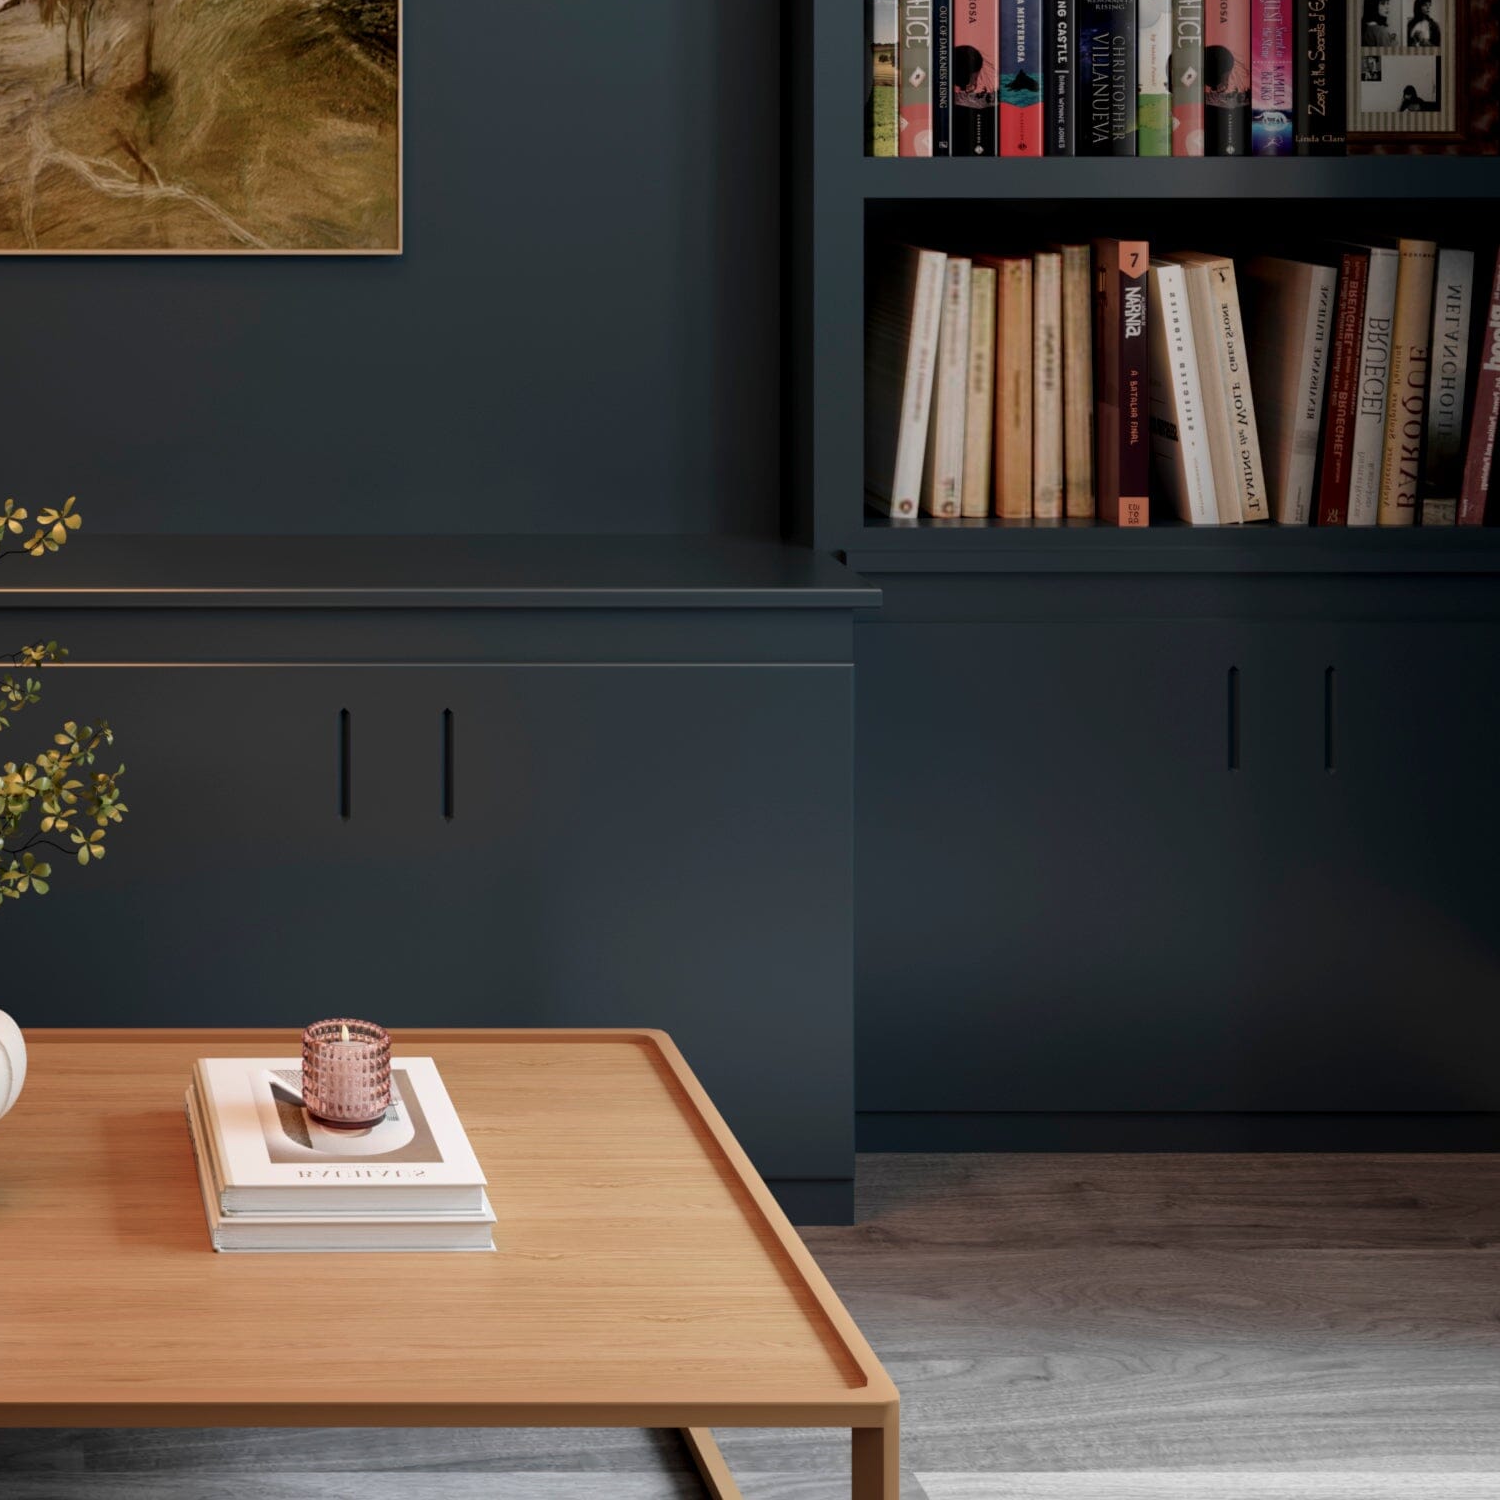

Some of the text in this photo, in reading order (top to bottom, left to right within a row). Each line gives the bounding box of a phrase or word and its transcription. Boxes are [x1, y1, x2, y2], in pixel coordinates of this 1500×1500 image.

[1016, 10, 1025, 63] MISTERIOSA
[1058, 22, 1068, 64] CASTLE
[1091, 33, 1109, 144] VILLANUEVA
[1113, 36, 1126, 141] CHRISTOPHER
[1261, 71, 1274, 101] BENKO
[1273, 65, 1284, 108] KAMILLA
[1131, 253, 1139, 268] 7
[1125, 287, 1142, 338] NARNIA
[1129, 380, 1138, 417] BATALHA
[1131, 421, 1139, 445] FINAL
